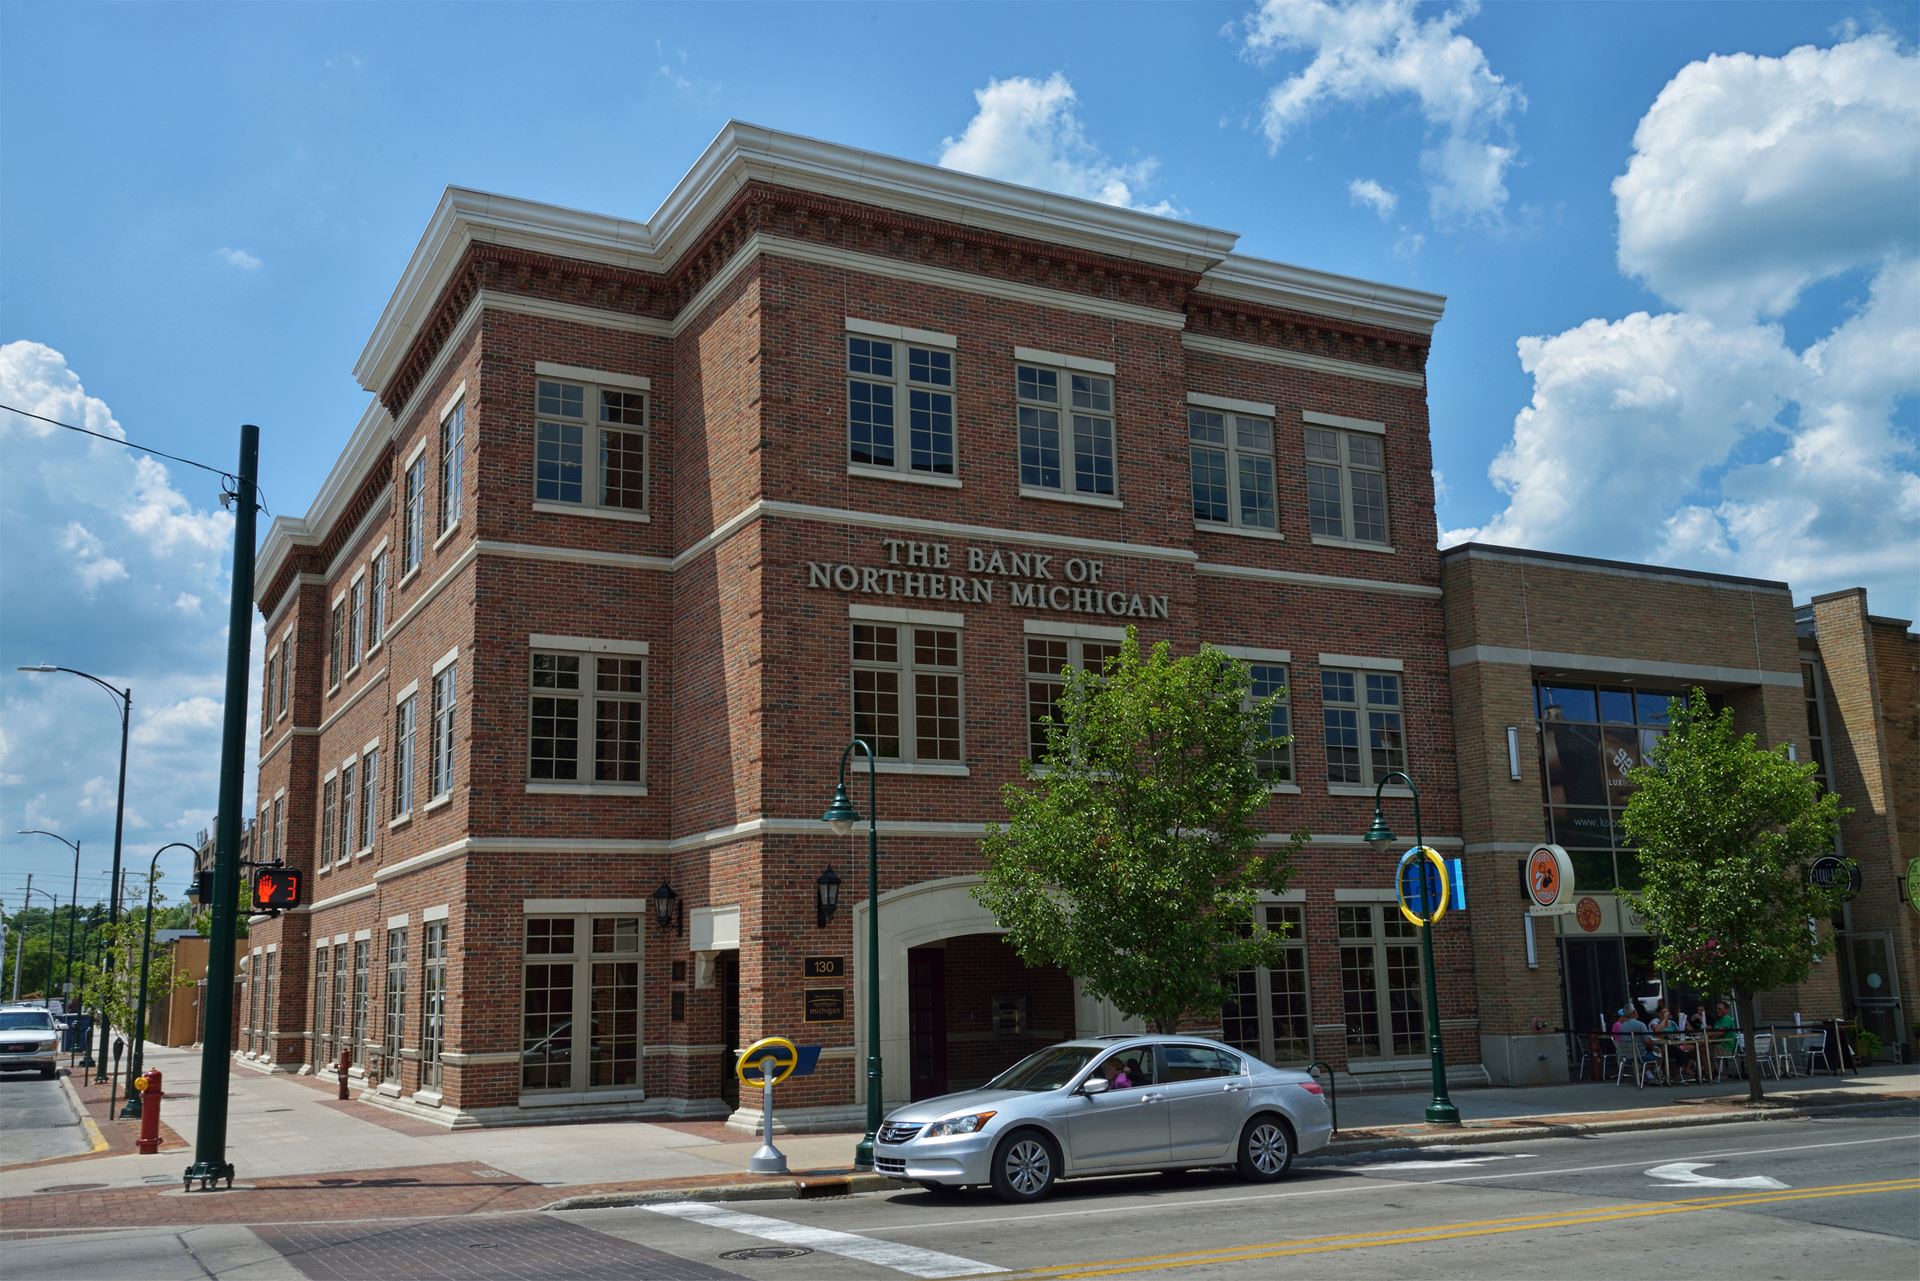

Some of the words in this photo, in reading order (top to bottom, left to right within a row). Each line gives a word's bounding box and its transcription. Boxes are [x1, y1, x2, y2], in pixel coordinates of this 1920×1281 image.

[881, 537, 951, 570] THE
[966, 547, 1054, 580] BANK
[1063, 558, 1104, 585] OF
[807, 561, 994, 604] NORTHERN
[1008, 581, 1170, 620] MICHIGAN
[287, 876, 297, 900] 3
[814, 961, 834, 973] 130
[810, 1007, 841, 1016] michigan
